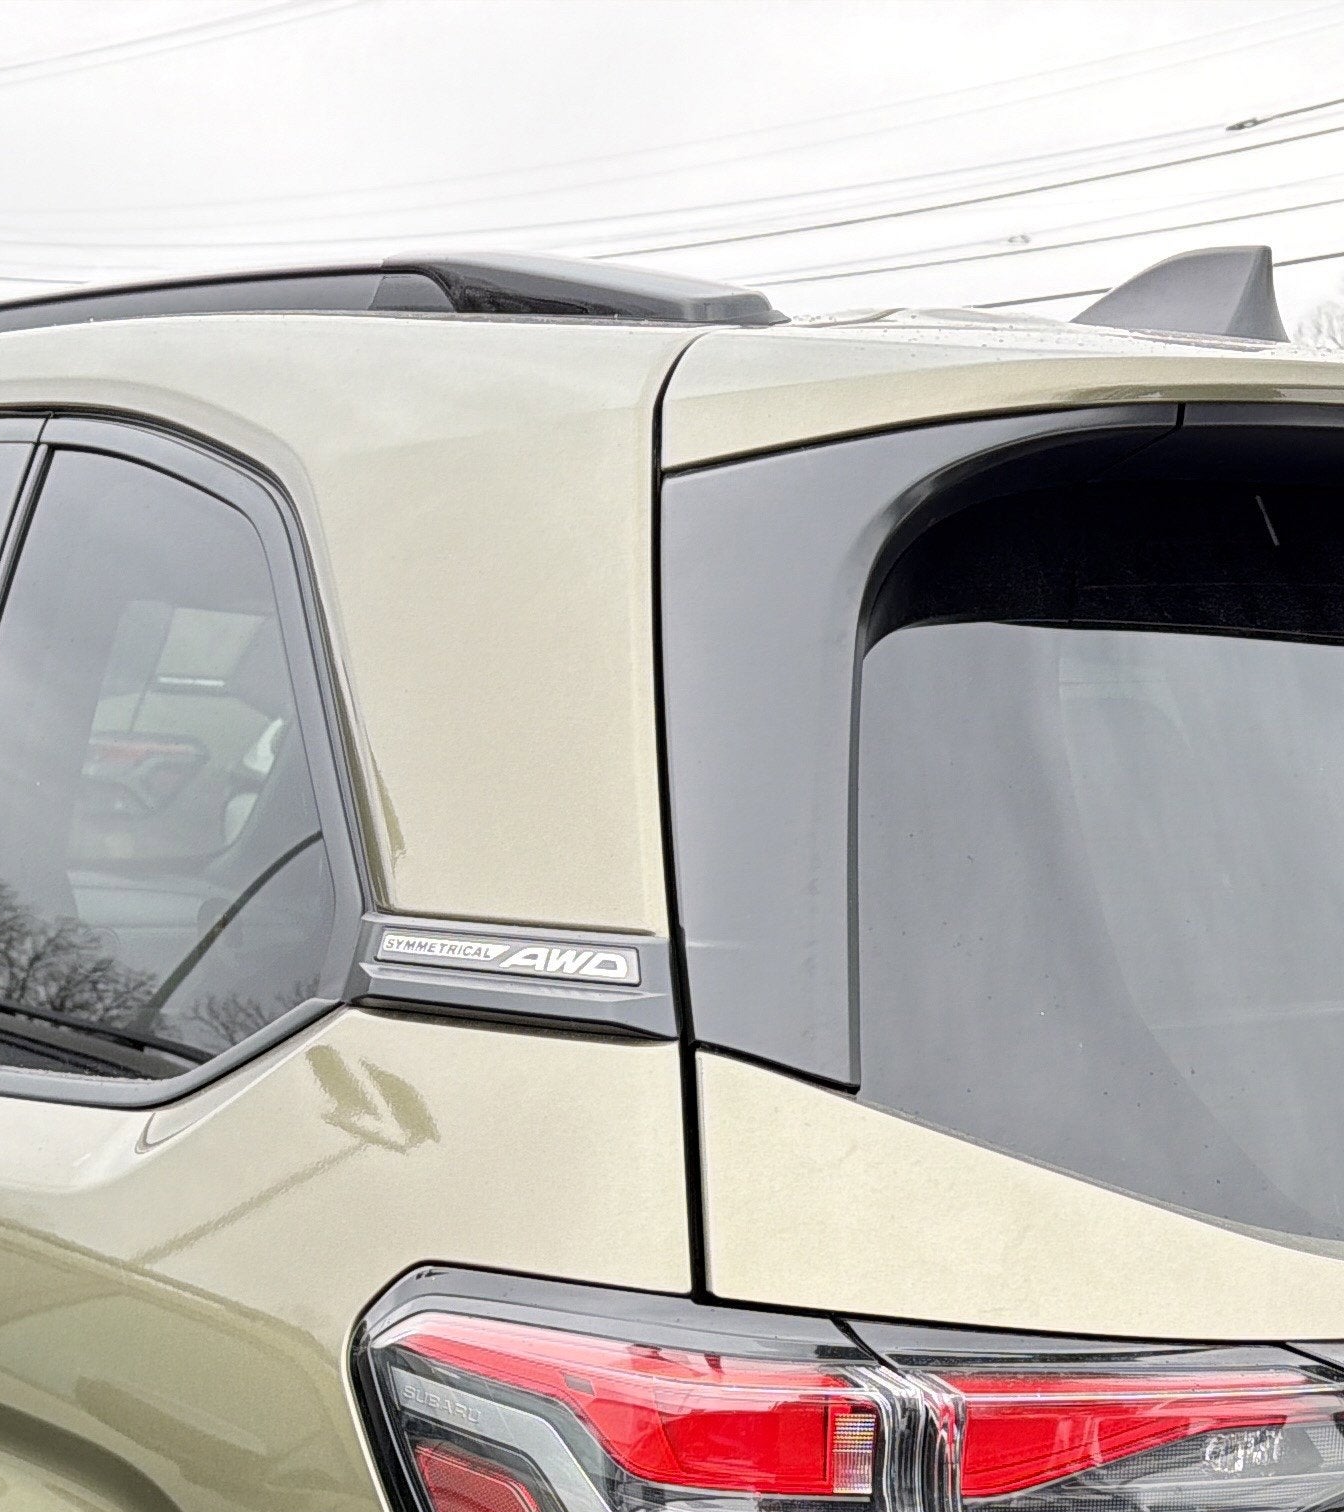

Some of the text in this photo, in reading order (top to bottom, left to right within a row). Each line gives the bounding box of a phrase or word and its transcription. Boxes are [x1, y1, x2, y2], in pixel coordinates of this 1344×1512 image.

[385, 937, 629, 979] SYMMETRICAL AWD
[402, 1384, 481, 1423] SUBARU
